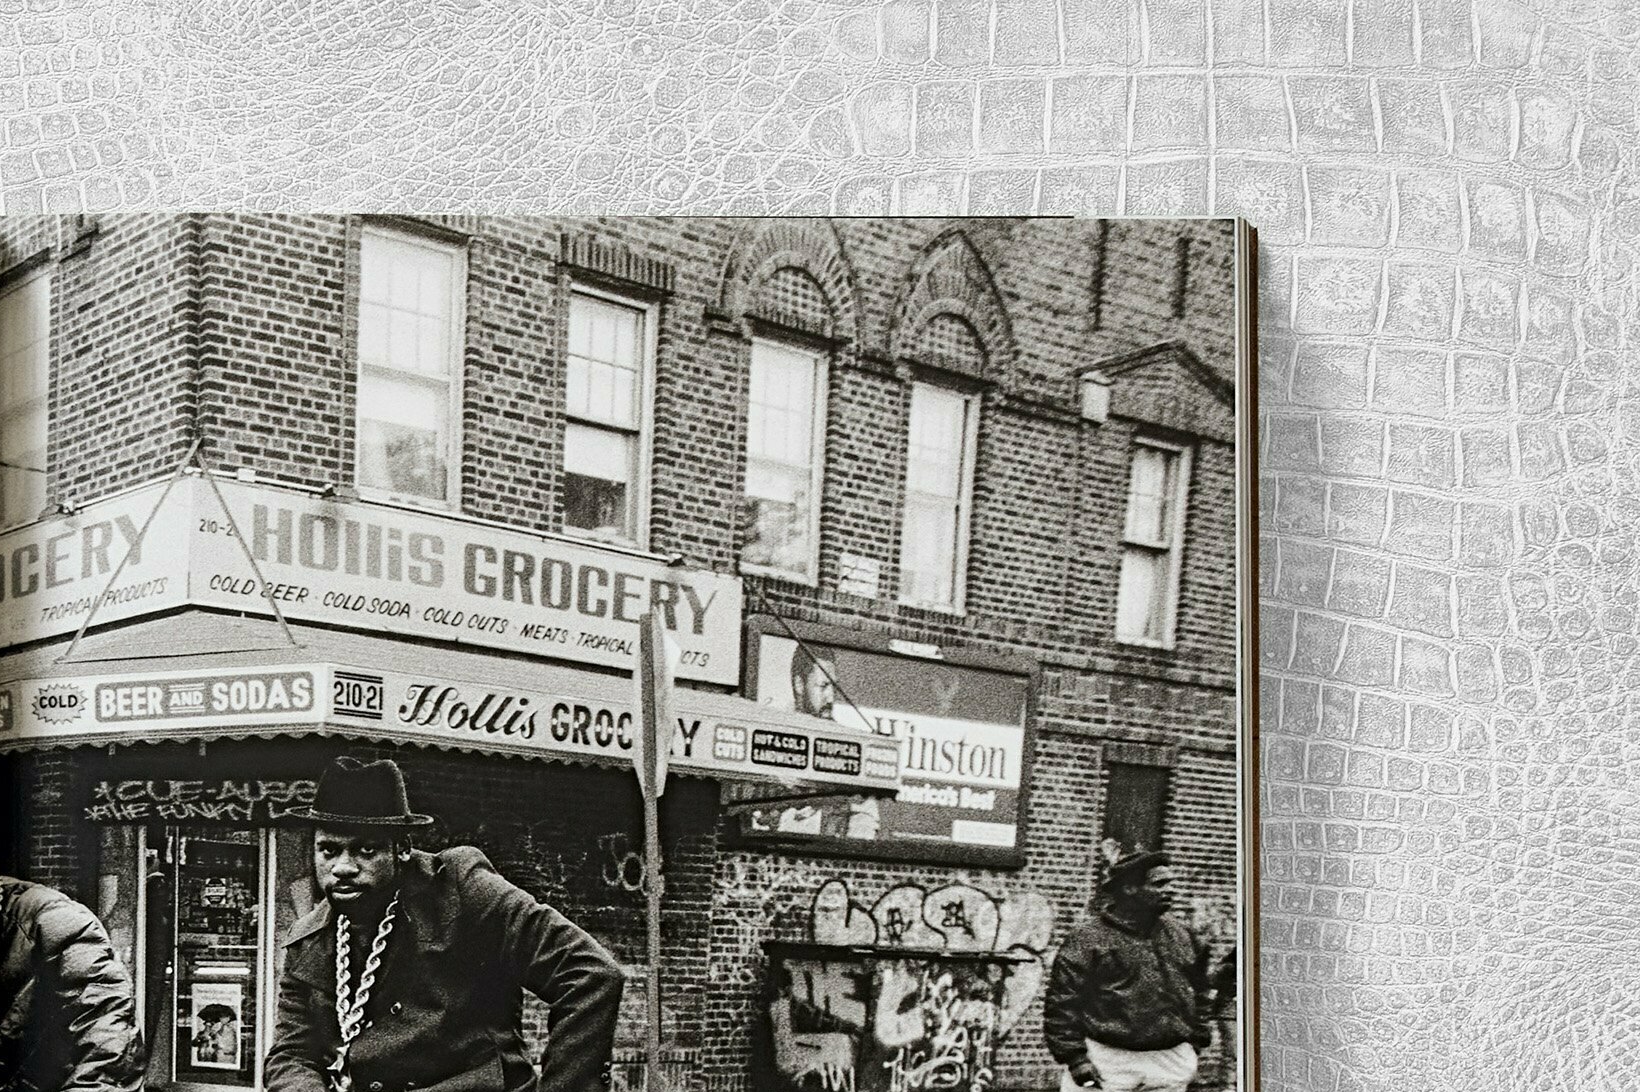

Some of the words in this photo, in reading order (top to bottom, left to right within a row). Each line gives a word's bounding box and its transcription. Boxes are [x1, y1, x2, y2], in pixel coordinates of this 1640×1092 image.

[199, 518, 238, 537] 210-2
[463, 543, 718, 636] GROCERY
[103, 577, 168, 608] PRODUCTS
[210, 574, 256, 596] COLD
[261, 581, 310, 603] BEER
[323, 591, 367, 612] COLD
[367, 597, 412, 619] SODA
[423, 606, 463, 628] COLD
[468, 614, 510, 636] CUTS
[520, 622, 569, 645] MEATS
[576, 632, 634, 656] TROPICAL
[39, 694, 78, 710] COLD
[99, 686, 164, 719] BEER
[169, 690, 204, 708] AND
[212, 678, 311, 711] SODAS
[397, 683, 539, 740] Hollis
[550, 702, 701, 759] GROCY
[782, 737, 806, 751] COLD
[815, 740, 860, 757] TROPICAL
[753, 749, 807, 767] SANDWICHES
[814, 756, 860, 773] PRODUCTS
